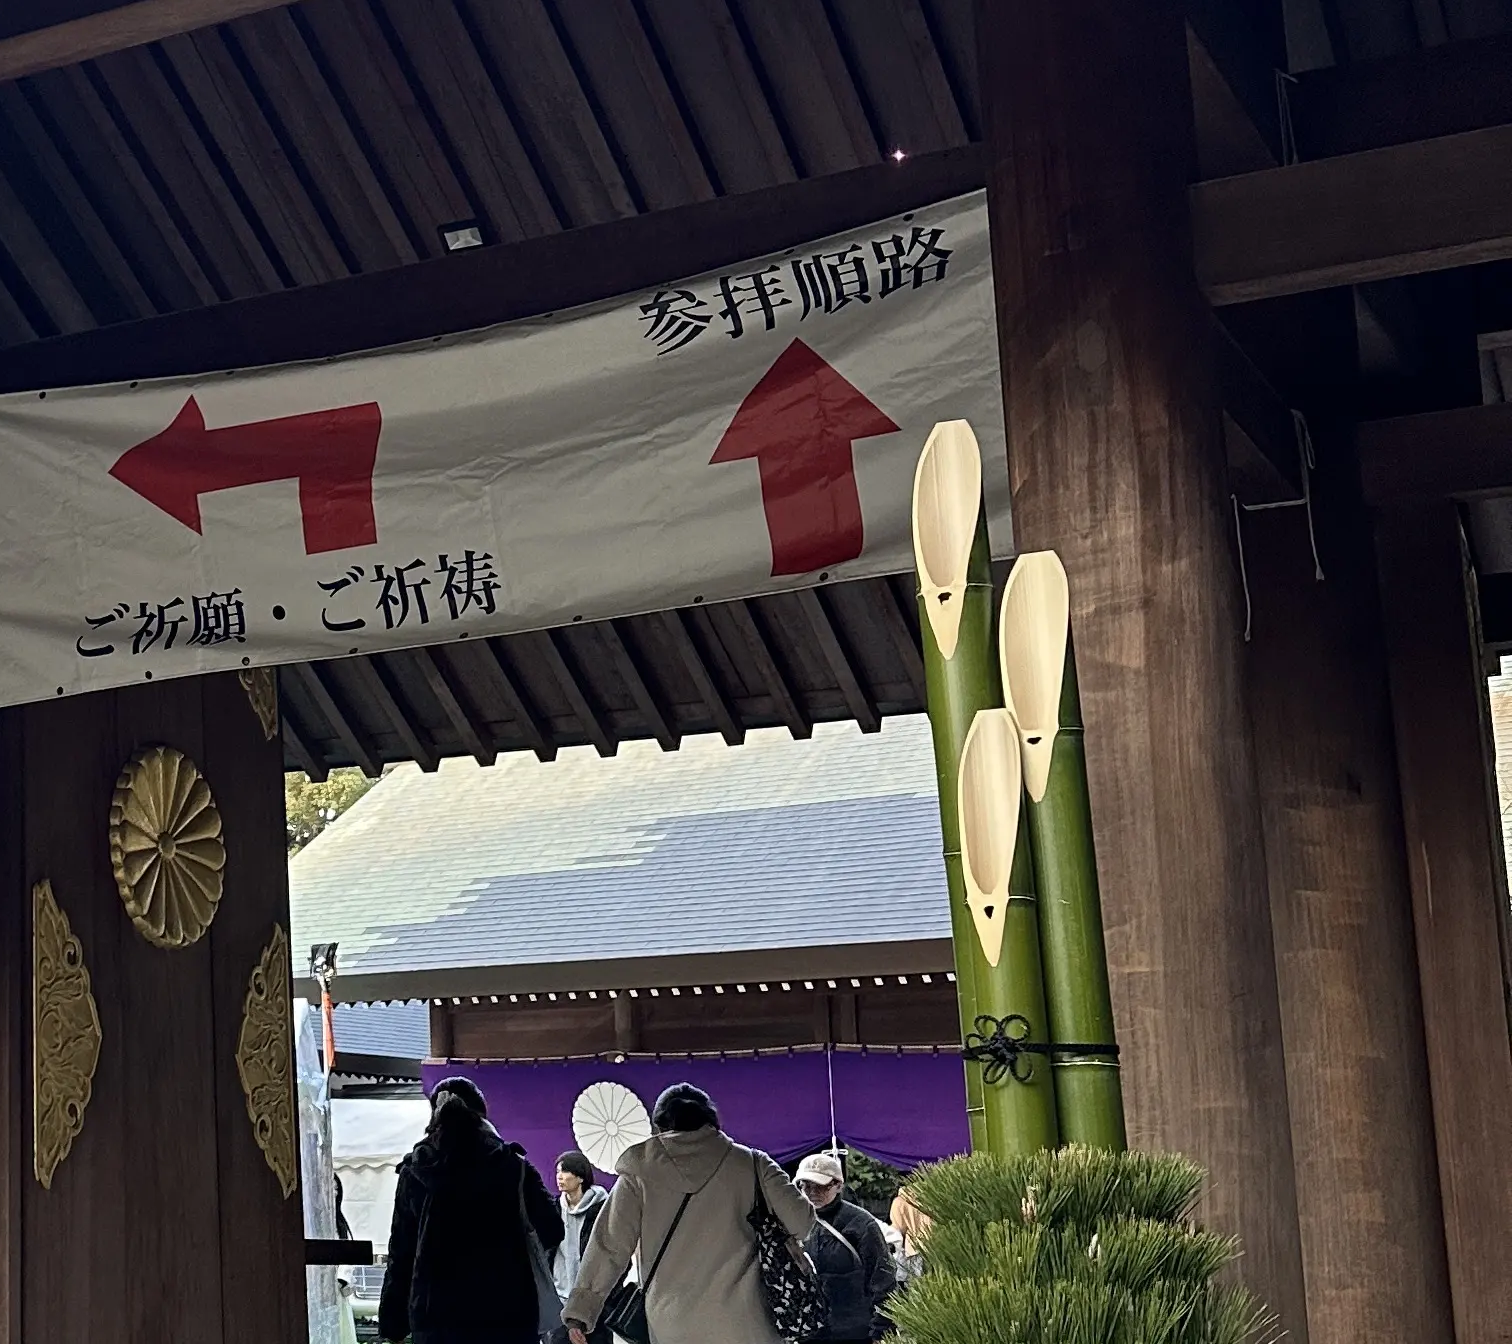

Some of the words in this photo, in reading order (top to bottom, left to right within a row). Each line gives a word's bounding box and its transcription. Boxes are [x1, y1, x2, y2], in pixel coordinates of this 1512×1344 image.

[638, 226, 954, 356] 参拝順路
[75, 549, 502, 657] ご祈願・ご祈祷
